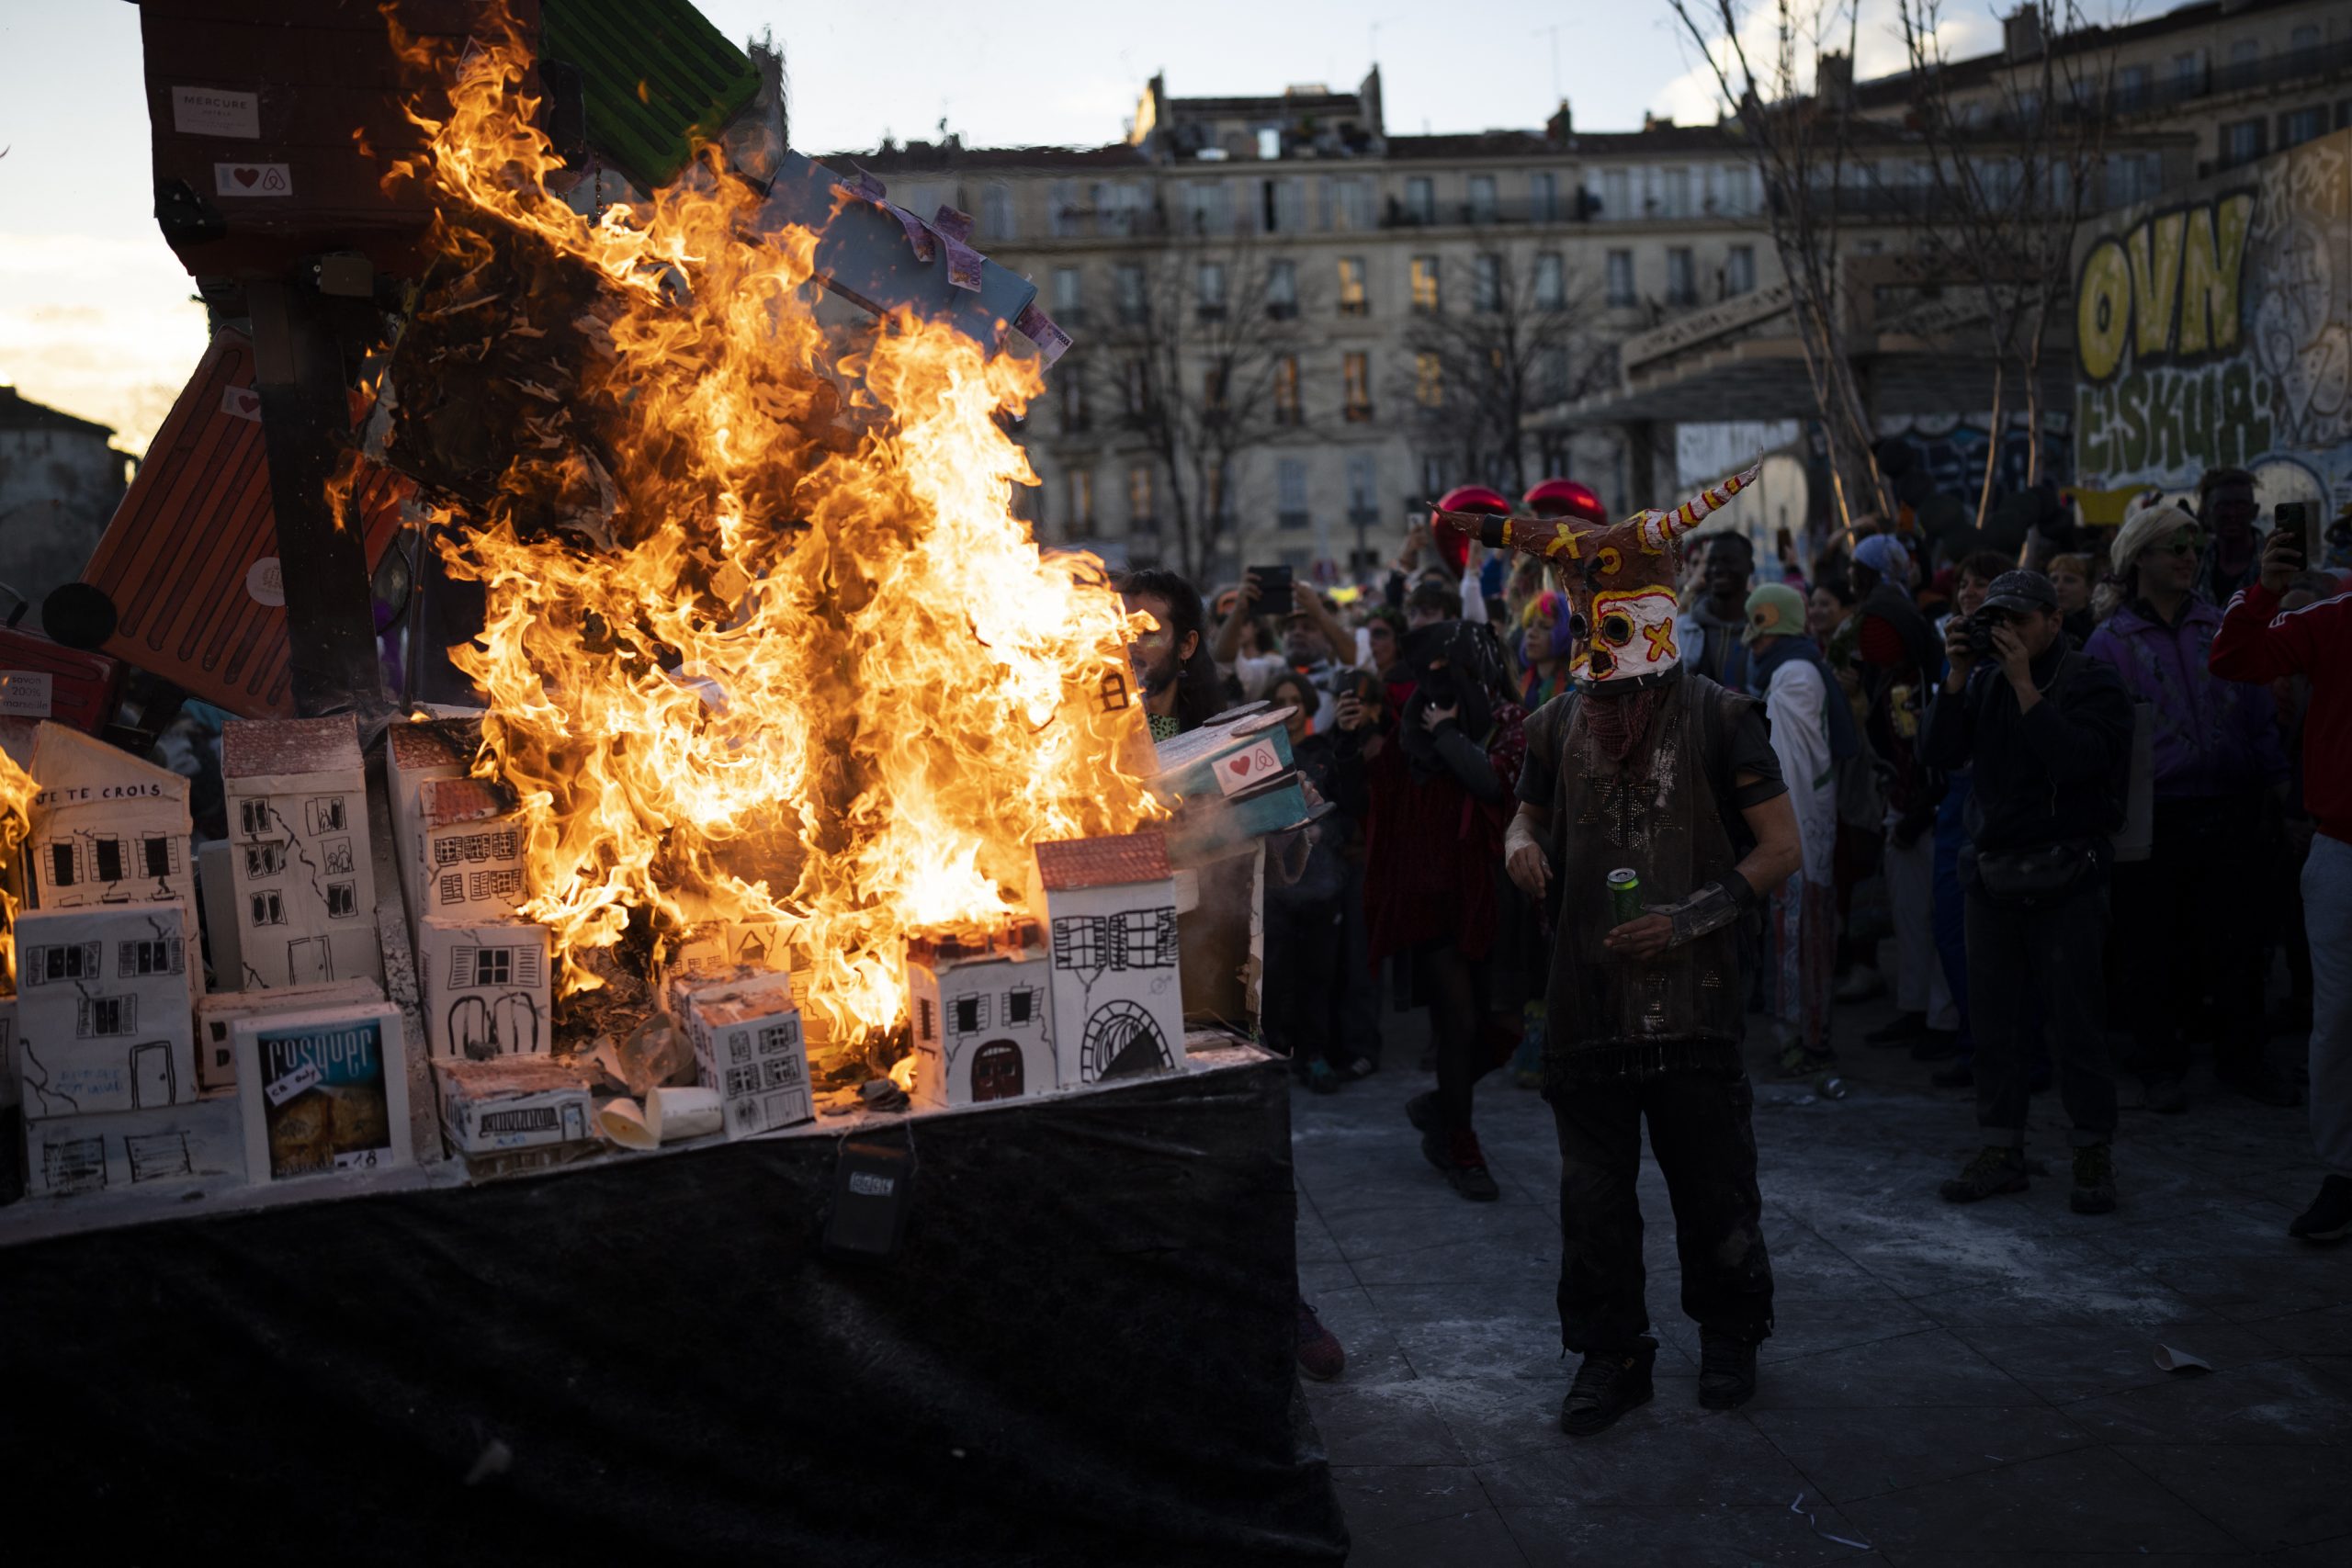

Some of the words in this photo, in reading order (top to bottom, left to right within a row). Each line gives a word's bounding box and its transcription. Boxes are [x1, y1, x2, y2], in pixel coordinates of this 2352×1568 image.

[184, 95, 248, 110] MERCURE
[12, 676, 41, 684] savon
[36, 792, 57, 806] JE
[66, 787, 90, 800] TE
[102, 784, 161, 798] CROIS
